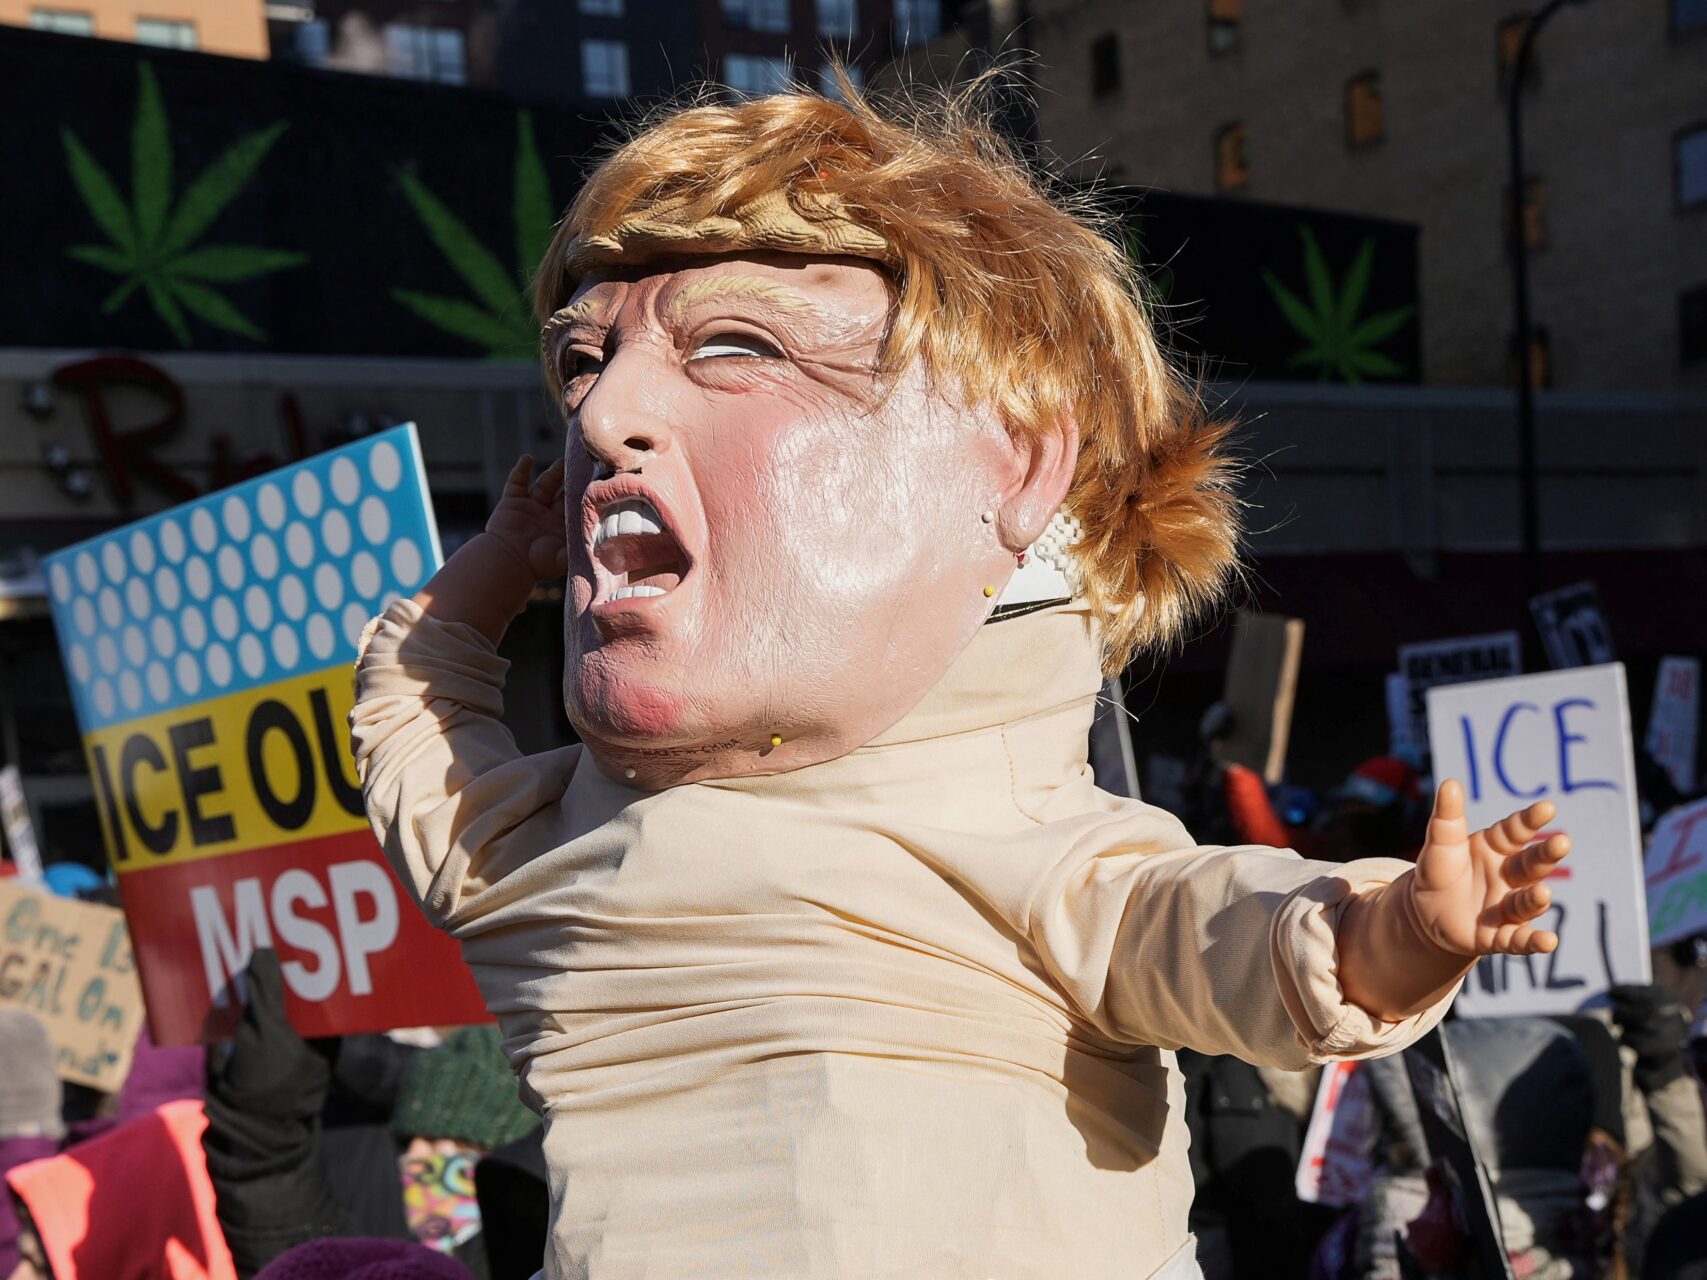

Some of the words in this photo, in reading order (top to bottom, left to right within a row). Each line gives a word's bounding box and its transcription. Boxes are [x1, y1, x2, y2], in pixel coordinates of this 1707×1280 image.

[93, 716, 239, 861] ICE
[245, 685, 367, 831] OU
[1459, 698, 1620, 802] ICE
[189, 859, 401, 1004] MSP
